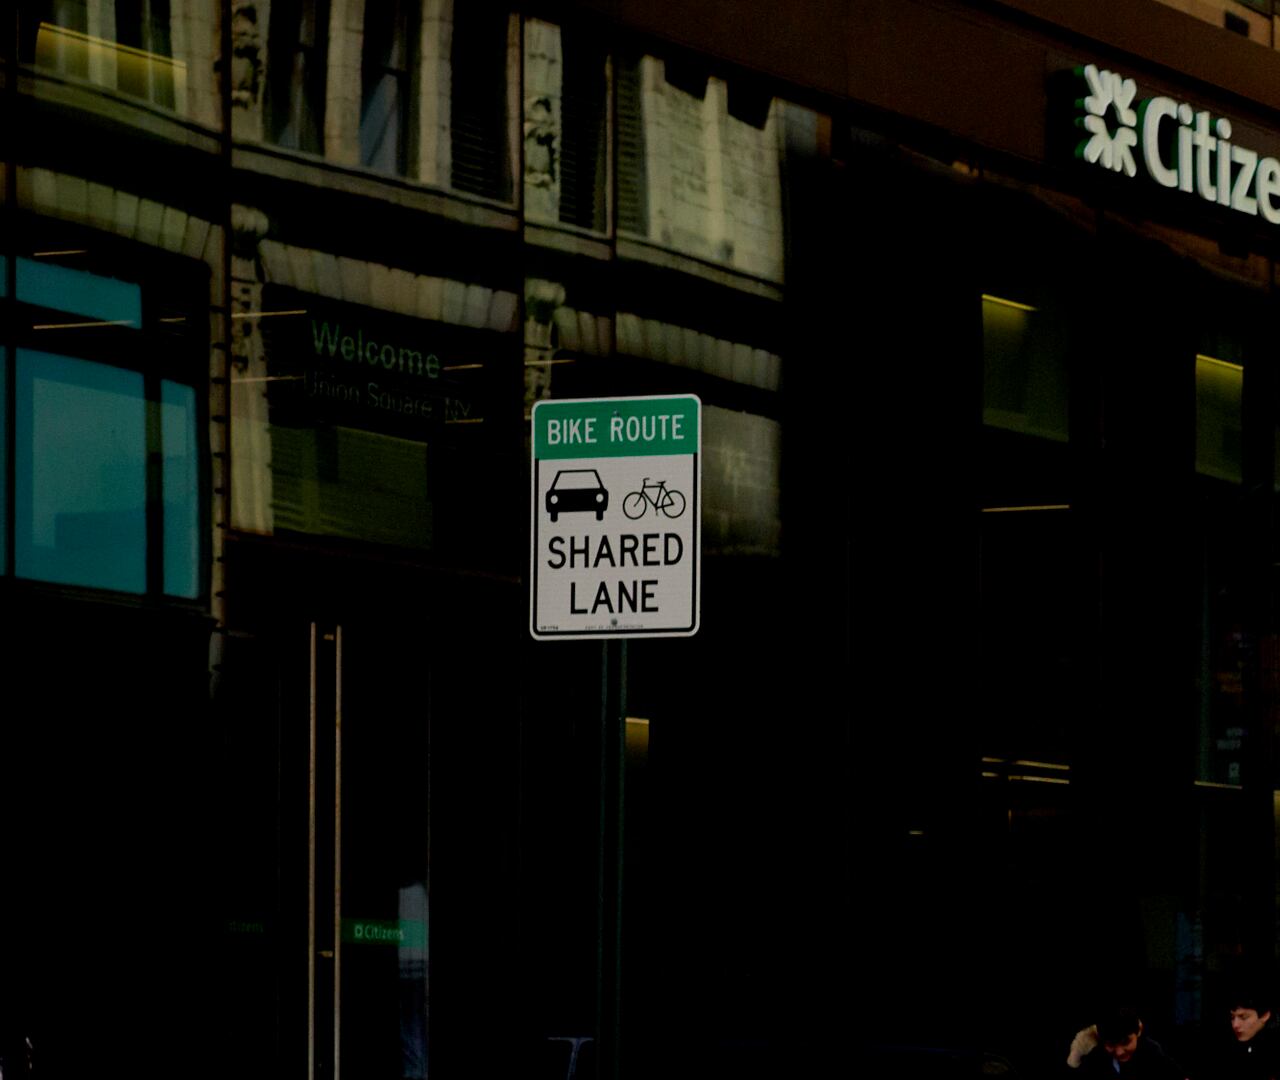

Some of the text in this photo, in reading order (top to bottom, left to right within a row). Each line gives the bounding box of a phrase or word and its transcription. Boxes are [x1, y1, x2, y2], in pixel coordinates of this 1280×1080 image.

[311, 319, 442, 379] Welcome
[547, 414, 685, 445] BIKE ROUTE
[547, 532, 684, 570] SHARED
[570, 579, 659, 615] LANE
[364, 923, 405, 940] Citizens
